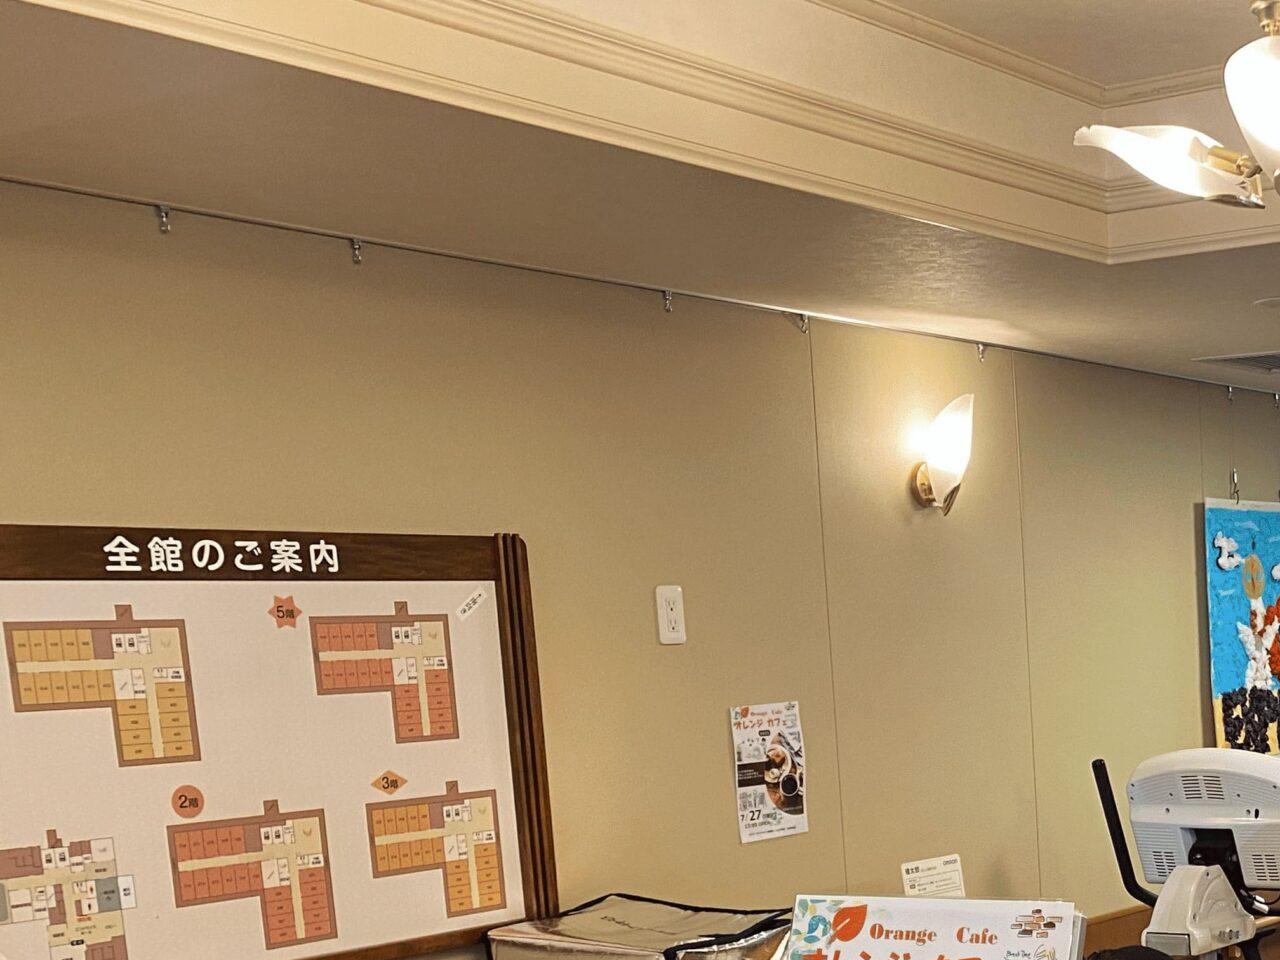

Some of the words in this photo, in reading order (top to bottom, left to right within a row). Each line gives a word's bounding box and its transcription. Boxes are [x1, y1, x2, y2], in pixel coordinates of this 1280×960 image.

[102, 536, 340, 573] 全館のご案内
[276, 605, 295, 619] 5階
[735, 719, 764, 730] オレンジ
[767, 718, 788, 727] カフェ
[382, 776, 399, 789] 3階
[178, 794, 199, 809] 2階
[869, 923, 938, 946] Orange
[956, 926, 998, 945] Cafe
